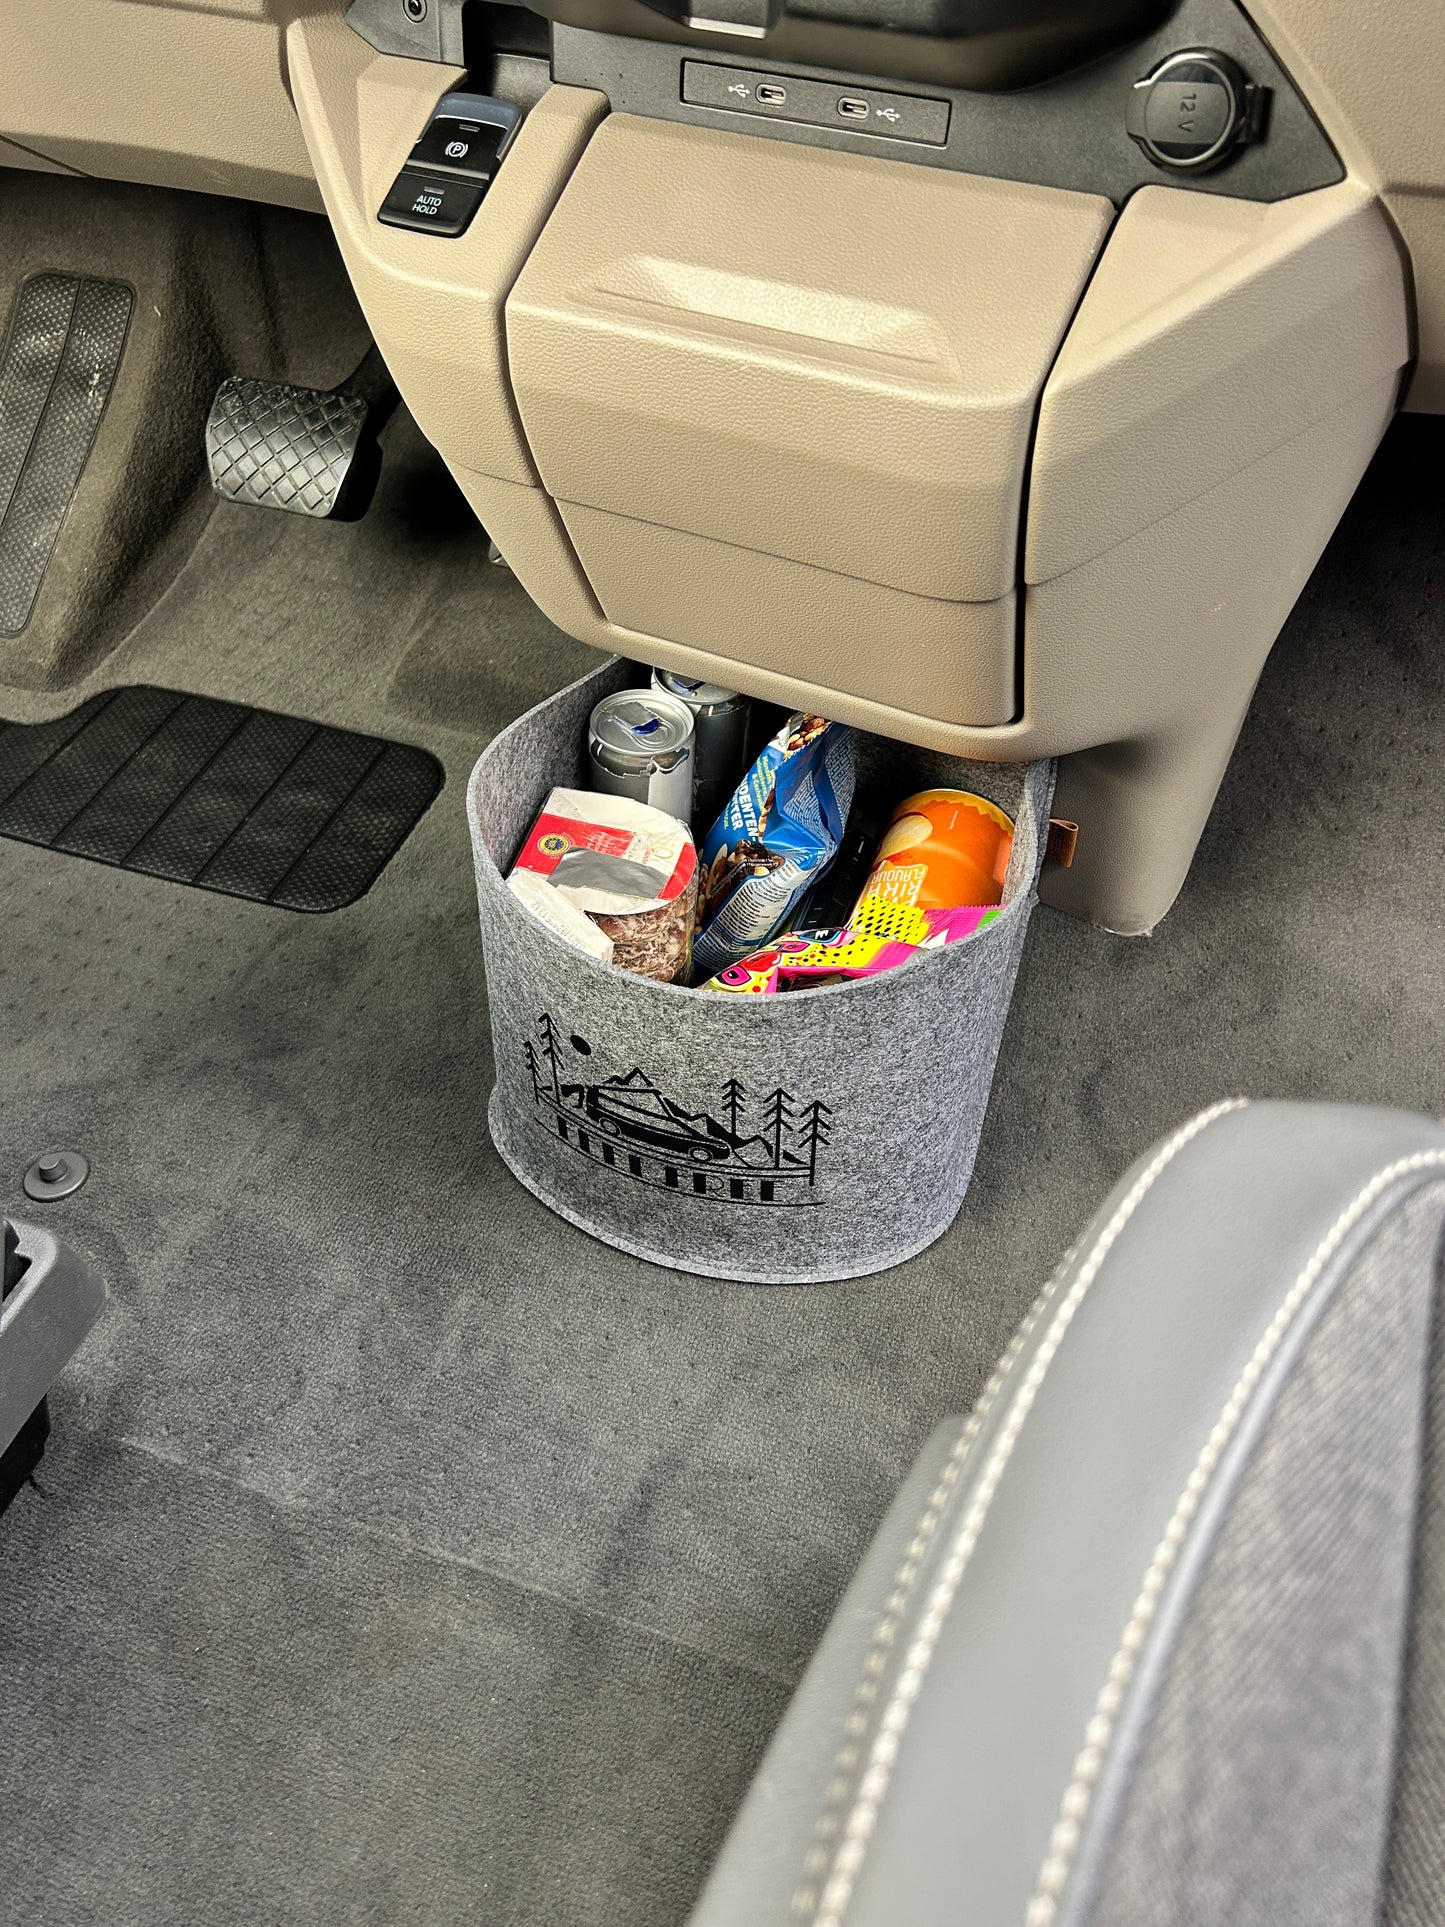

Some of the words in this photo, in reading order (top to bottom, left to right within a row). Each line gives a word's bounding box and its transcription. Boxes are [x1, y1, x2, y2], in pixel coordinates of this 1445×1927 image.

[1180, 93, 1197, 113] 12
[1178, 119, 1194, 133] V
[416, 194, 442, 207] AUTO
[412, 204, 438, 216] HOLD
[664, 1164, 786, 1202] FREE
